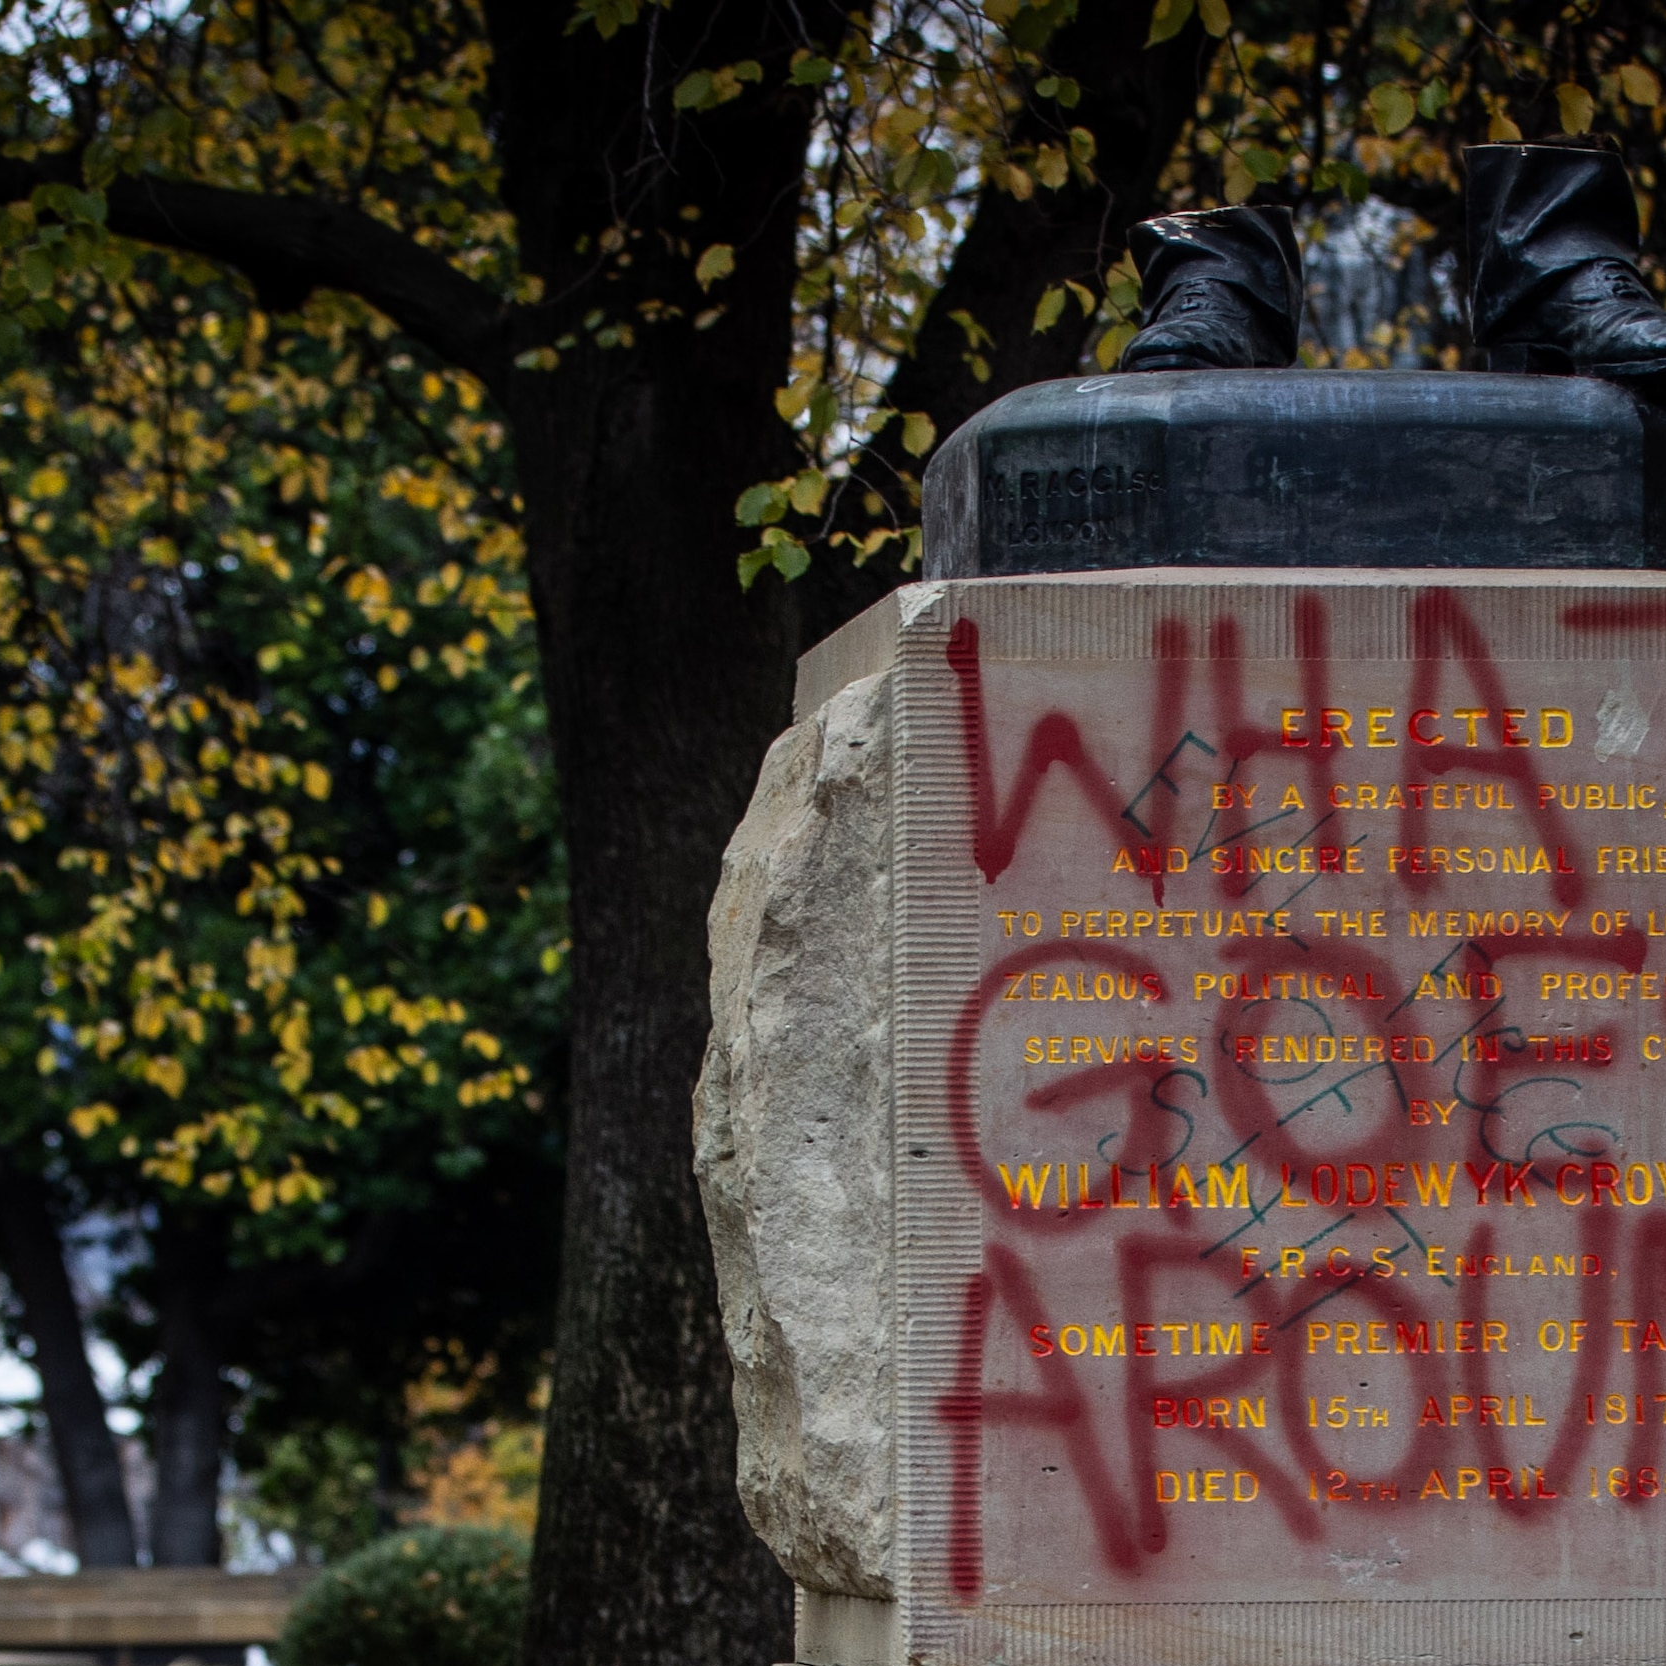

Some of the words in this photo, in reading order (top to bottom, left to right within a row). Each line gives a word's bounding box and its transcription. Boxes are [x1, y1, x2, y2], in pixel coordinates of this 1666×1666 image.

[1009, 519, 1117, 548] LONDON
[1281, 706, 1575, 748] ERECTED
[1212, 783, 1258, 810] BY
[1280, 783, 1304, 810] A
[1328, 783, 1515, 810] GRATEFUL
[1111, 846, 1190, 875] AND
[1211, 846, 1366, 874] SINCERE
[1388, 846, 1575, 874] PERSONAL
[997, 910, 1042, 938] TO
[1060, 910, 1292, 938] PERPETUATE
[1314, 910, 1387, 938] THE
[1409, 910, 1572, 938] MEMORY
[1590, 910, 1631, 938] OF
[1004, 972, 1163, 1001] ZEALOUS
[1193, 972, 1385, 1001] POLITICAL
[1415, 972, 1502, 1000] AND
[1024, 1036, 1199, 1064] SERVICES
[1236, 1036, 1435, 1063] RENDERED
[1461, 1035, 1499, 1062] IN
[1528, 1035, 1614, 1062] THIS
[1410, 1100, 1459, 1127] BY
[997, 1162, 1250, 1210] WILLIAM
[1279, 1161, 1537, 1208] LODEWYK
[1241, 1247, 1410, 1278] F.R.C.S.
[1029, 1322, 1271, 1358] SOMETIME
[1307, 1321, 1509, 1354] PREMIER
[1538, 1319, 1588, 1353] OF
[1153, 1396, 1267, 1429] BORN
[1418, 1394, 1547, 1427] APRIL
[1156, 1470, 1260, 1503] DIED
[1420, 1466, 1558, 1500] APRIL
